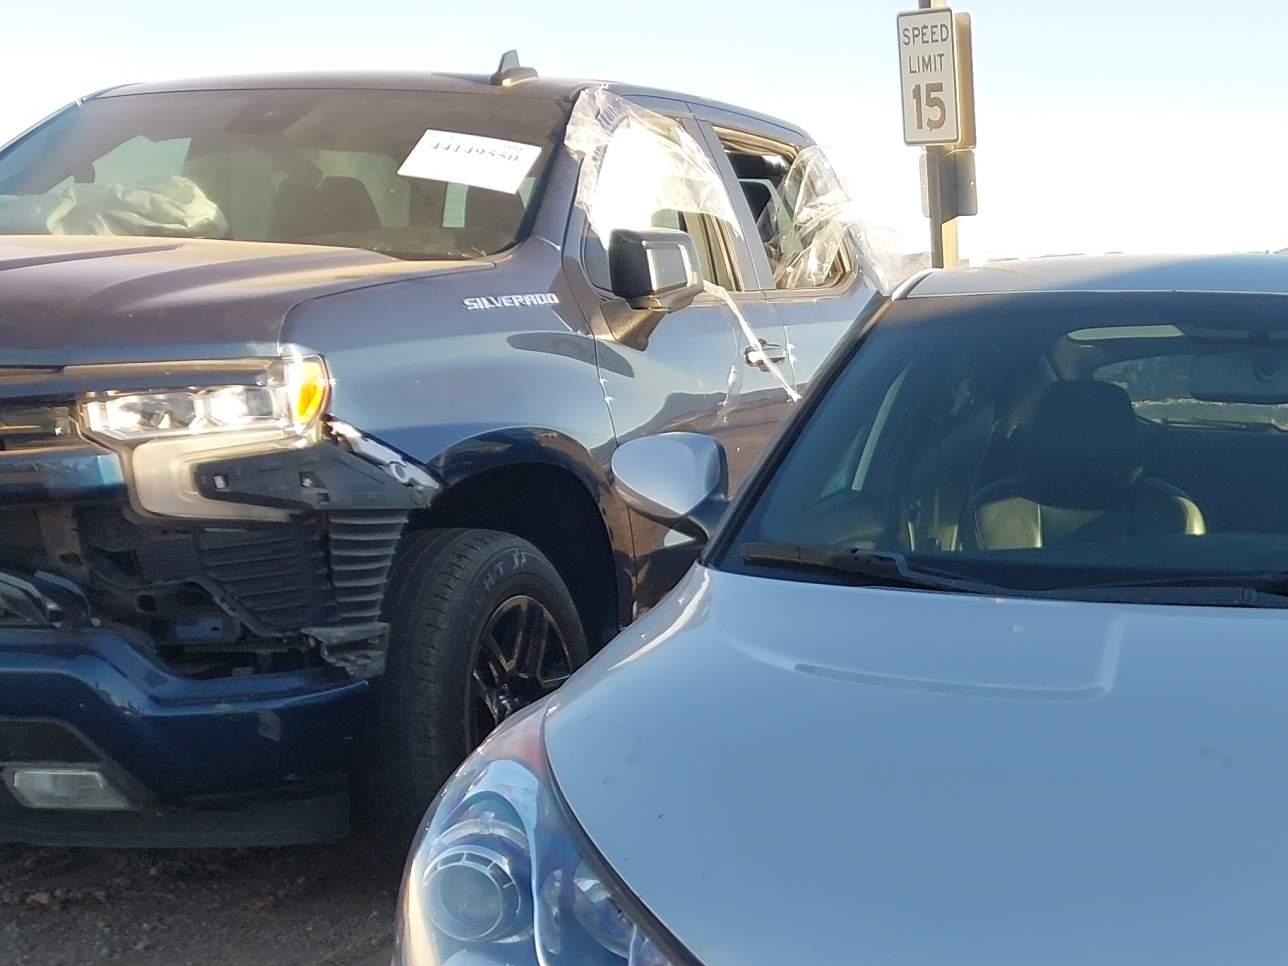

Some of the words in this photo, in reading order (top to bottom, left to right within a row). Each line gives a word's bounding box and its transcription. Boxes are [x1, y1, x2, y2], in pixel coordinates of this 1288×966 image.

[902, 23, 949, 46] SPEED
[908, 53, 945, 74] LIMIT
[912, 82, 947, 130] 15
[463, 292, 560, 311] SILVERADO
